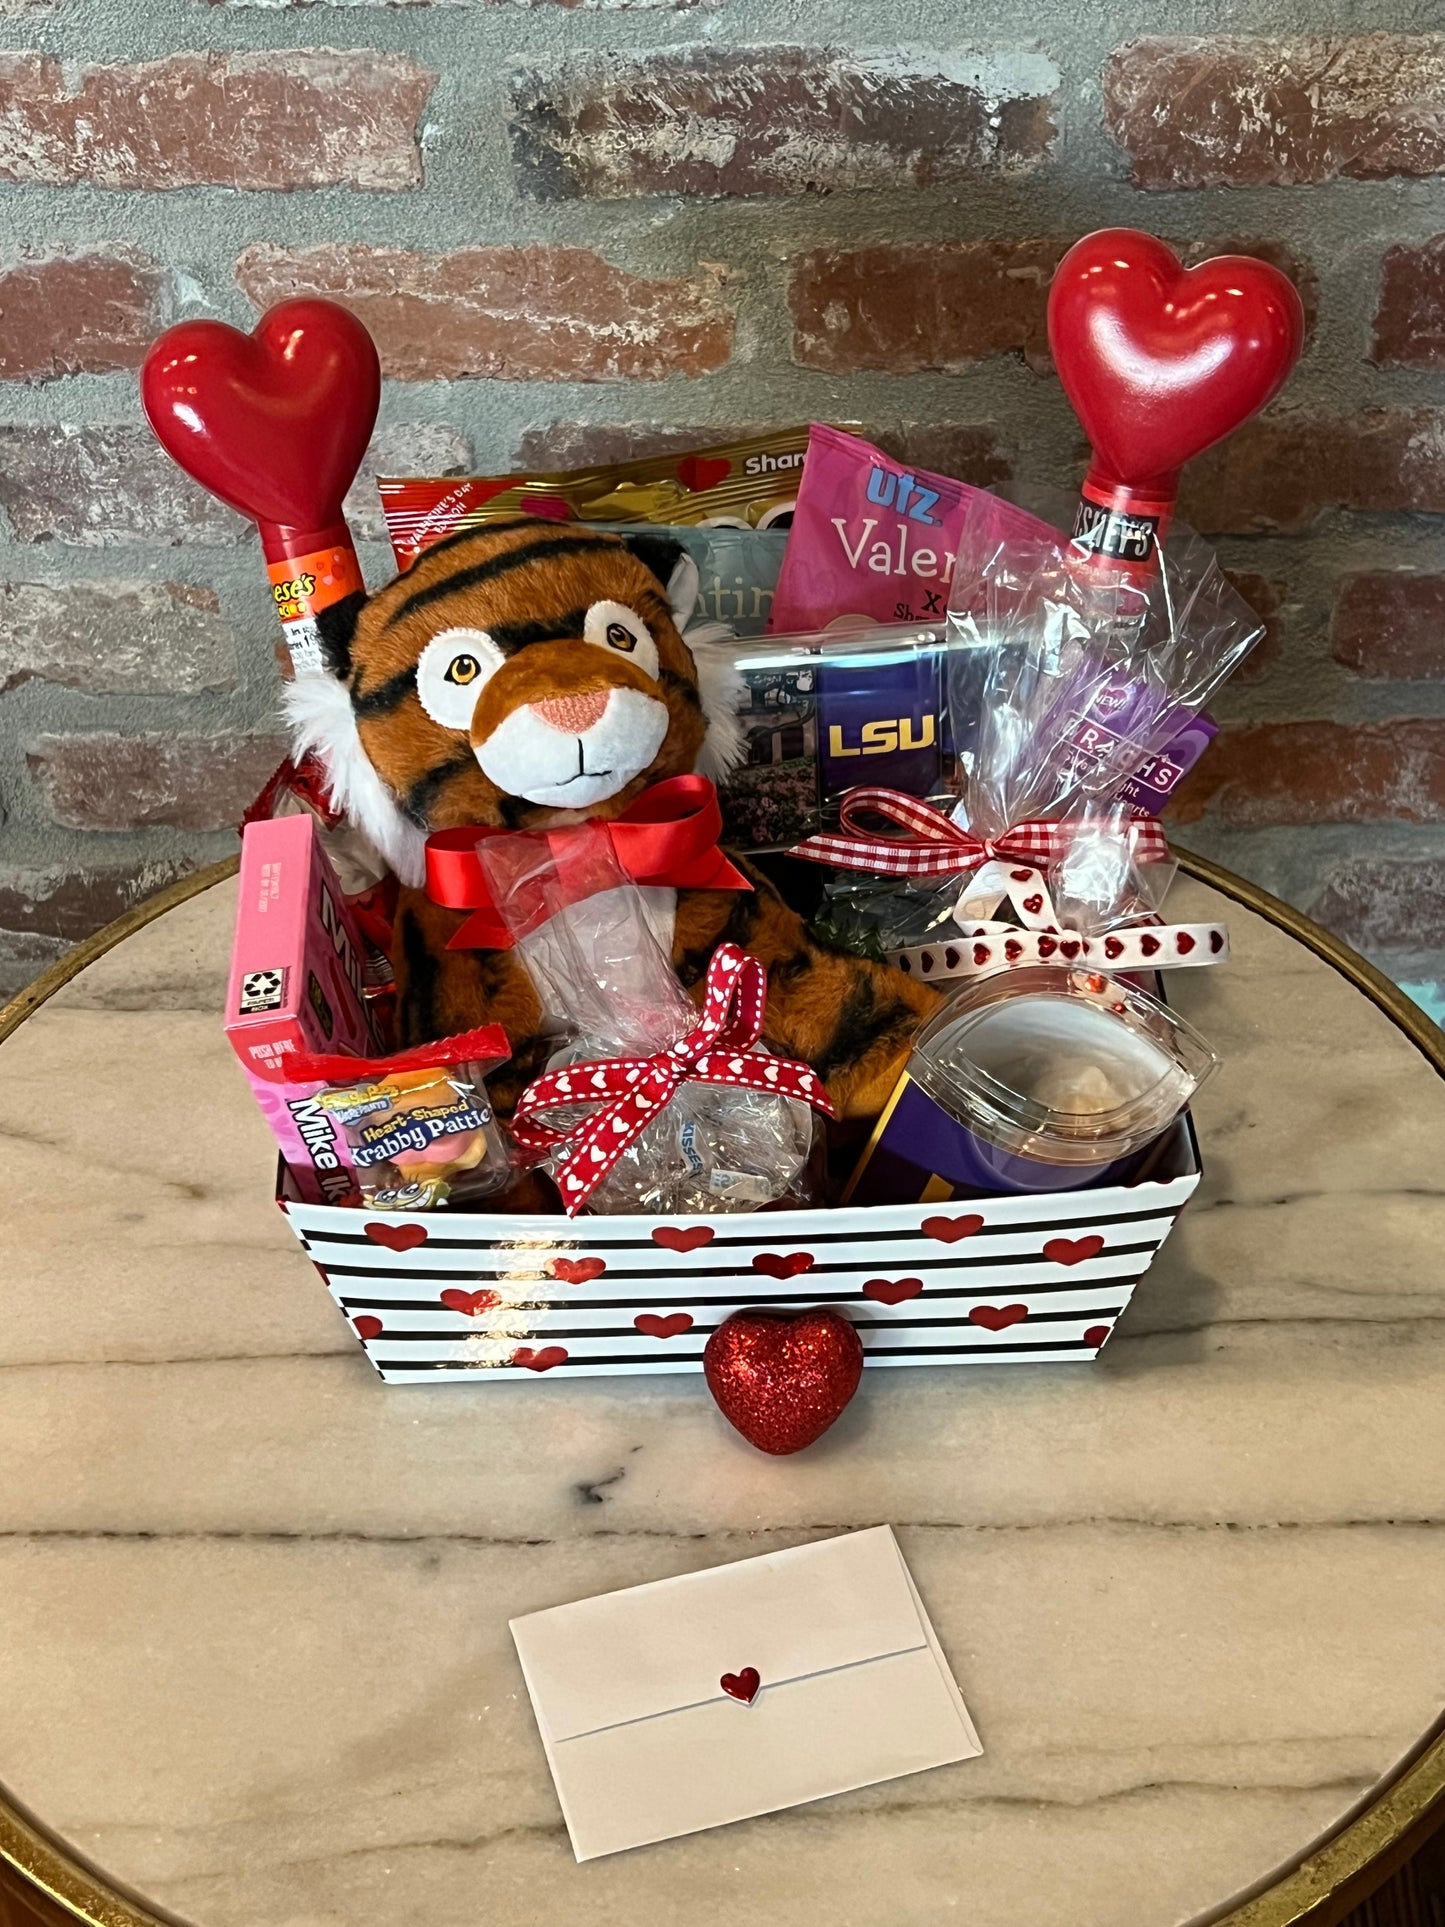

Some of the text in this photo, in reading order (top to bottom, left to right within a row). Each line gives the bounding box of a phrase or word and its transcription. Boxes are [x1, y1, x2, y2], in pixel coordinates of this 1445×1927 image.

[829, 714, 935, 758] LSU
[289, 1099, 339, 1171] Mike
[364, 1099, 469, 1143] Heart-Shaped
